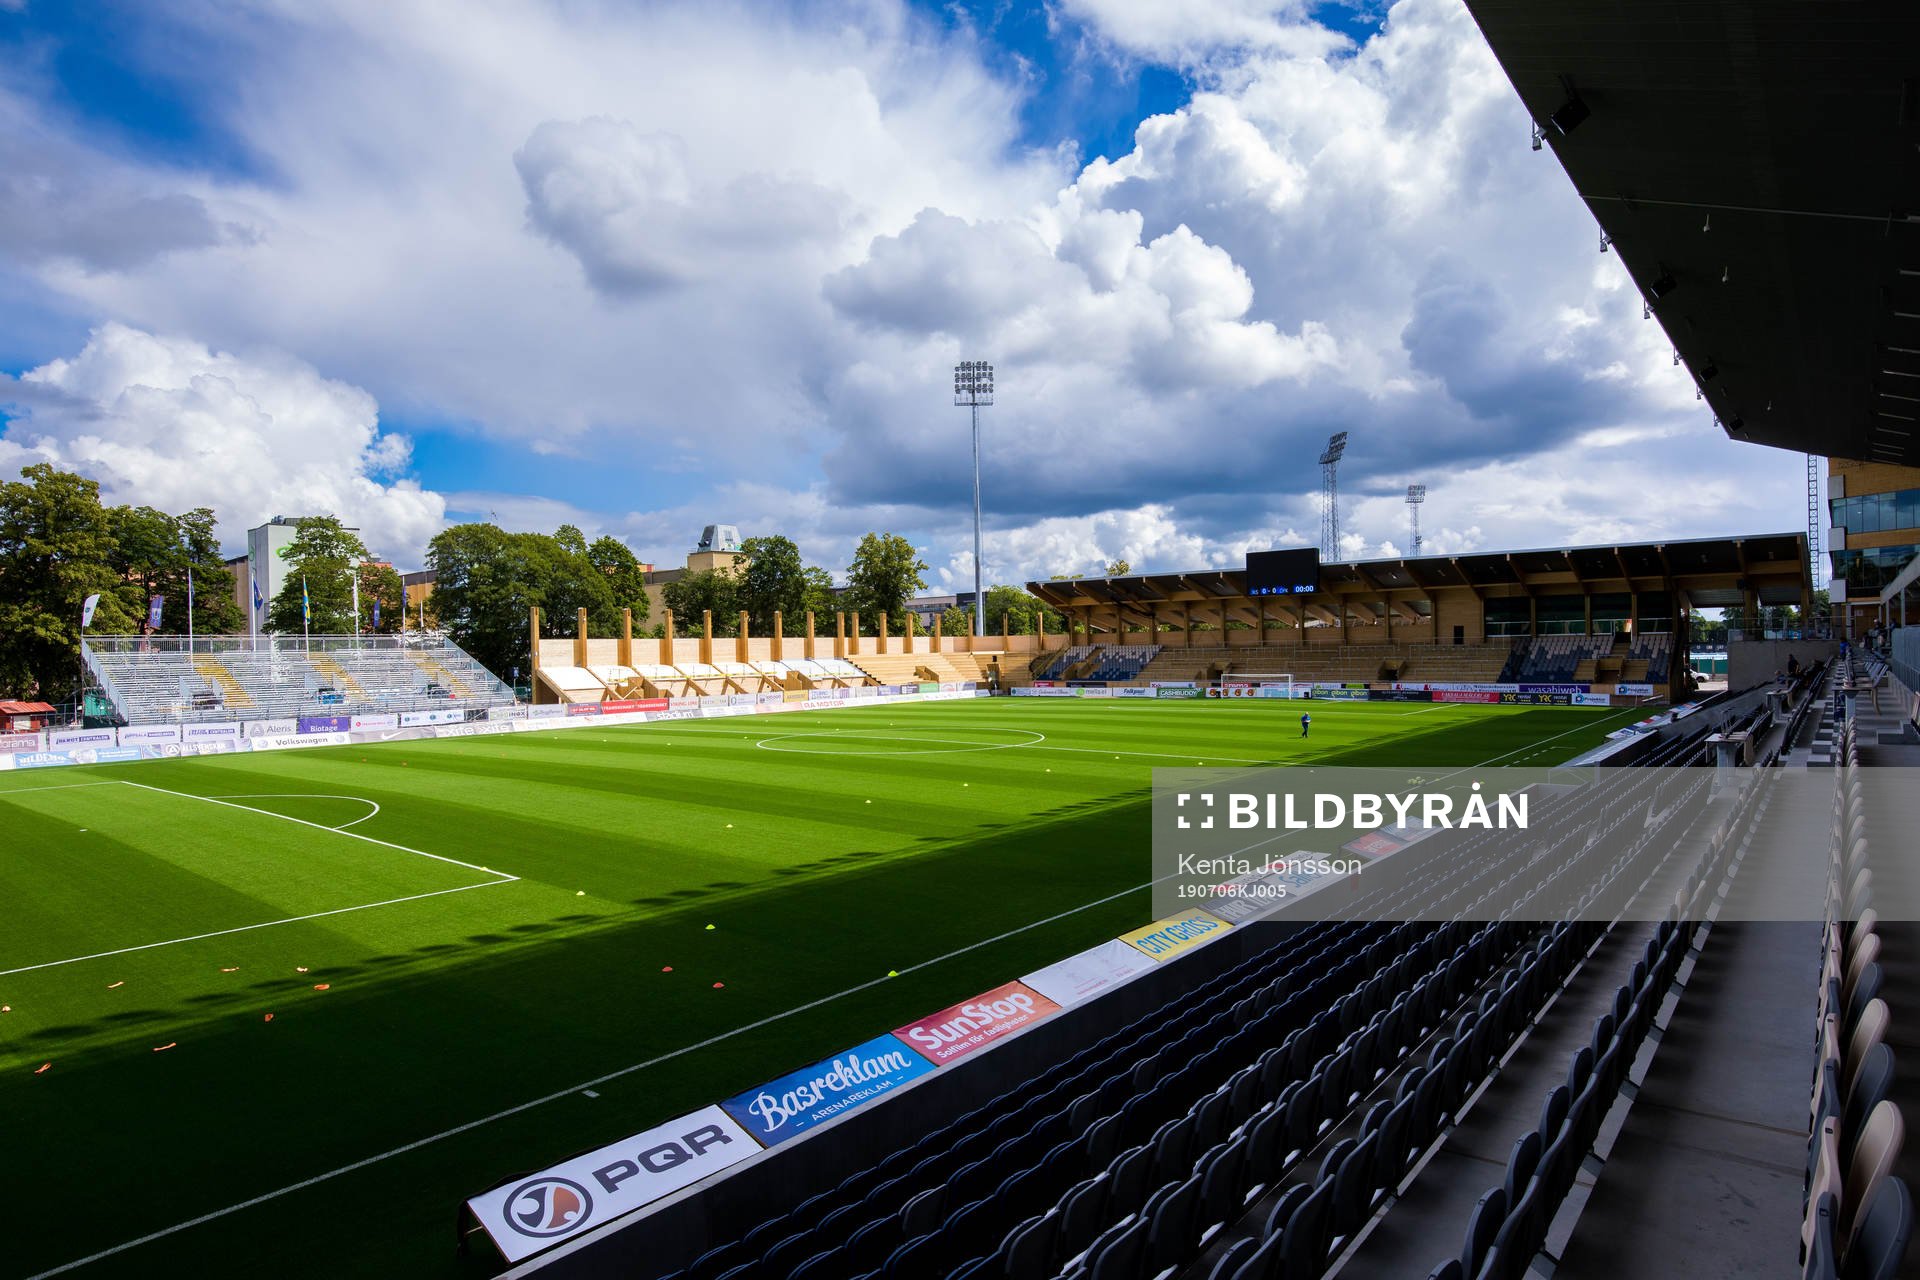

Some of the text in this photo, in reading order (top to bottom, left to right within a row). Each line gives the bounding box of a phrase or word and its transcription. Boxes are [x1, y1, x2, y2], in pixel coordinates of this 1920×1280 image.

[266, 723, 292, 733] Aleris
[275, 737, 329, 747] Volkswagen
[310, 725, 338, 734] Biotage
[1136, 916, 1219, 954] CITY GROSS
[908, 993, 1036, 1050] SunStop
[936, 1014, 1030, 1059] Solfilm för fastigheter
[748, 1050, 912, 1133] Basreklam
[811, 1080, 894, 1121] ARENAREKLAM
[592, 1124, 734, 1194] PQR
